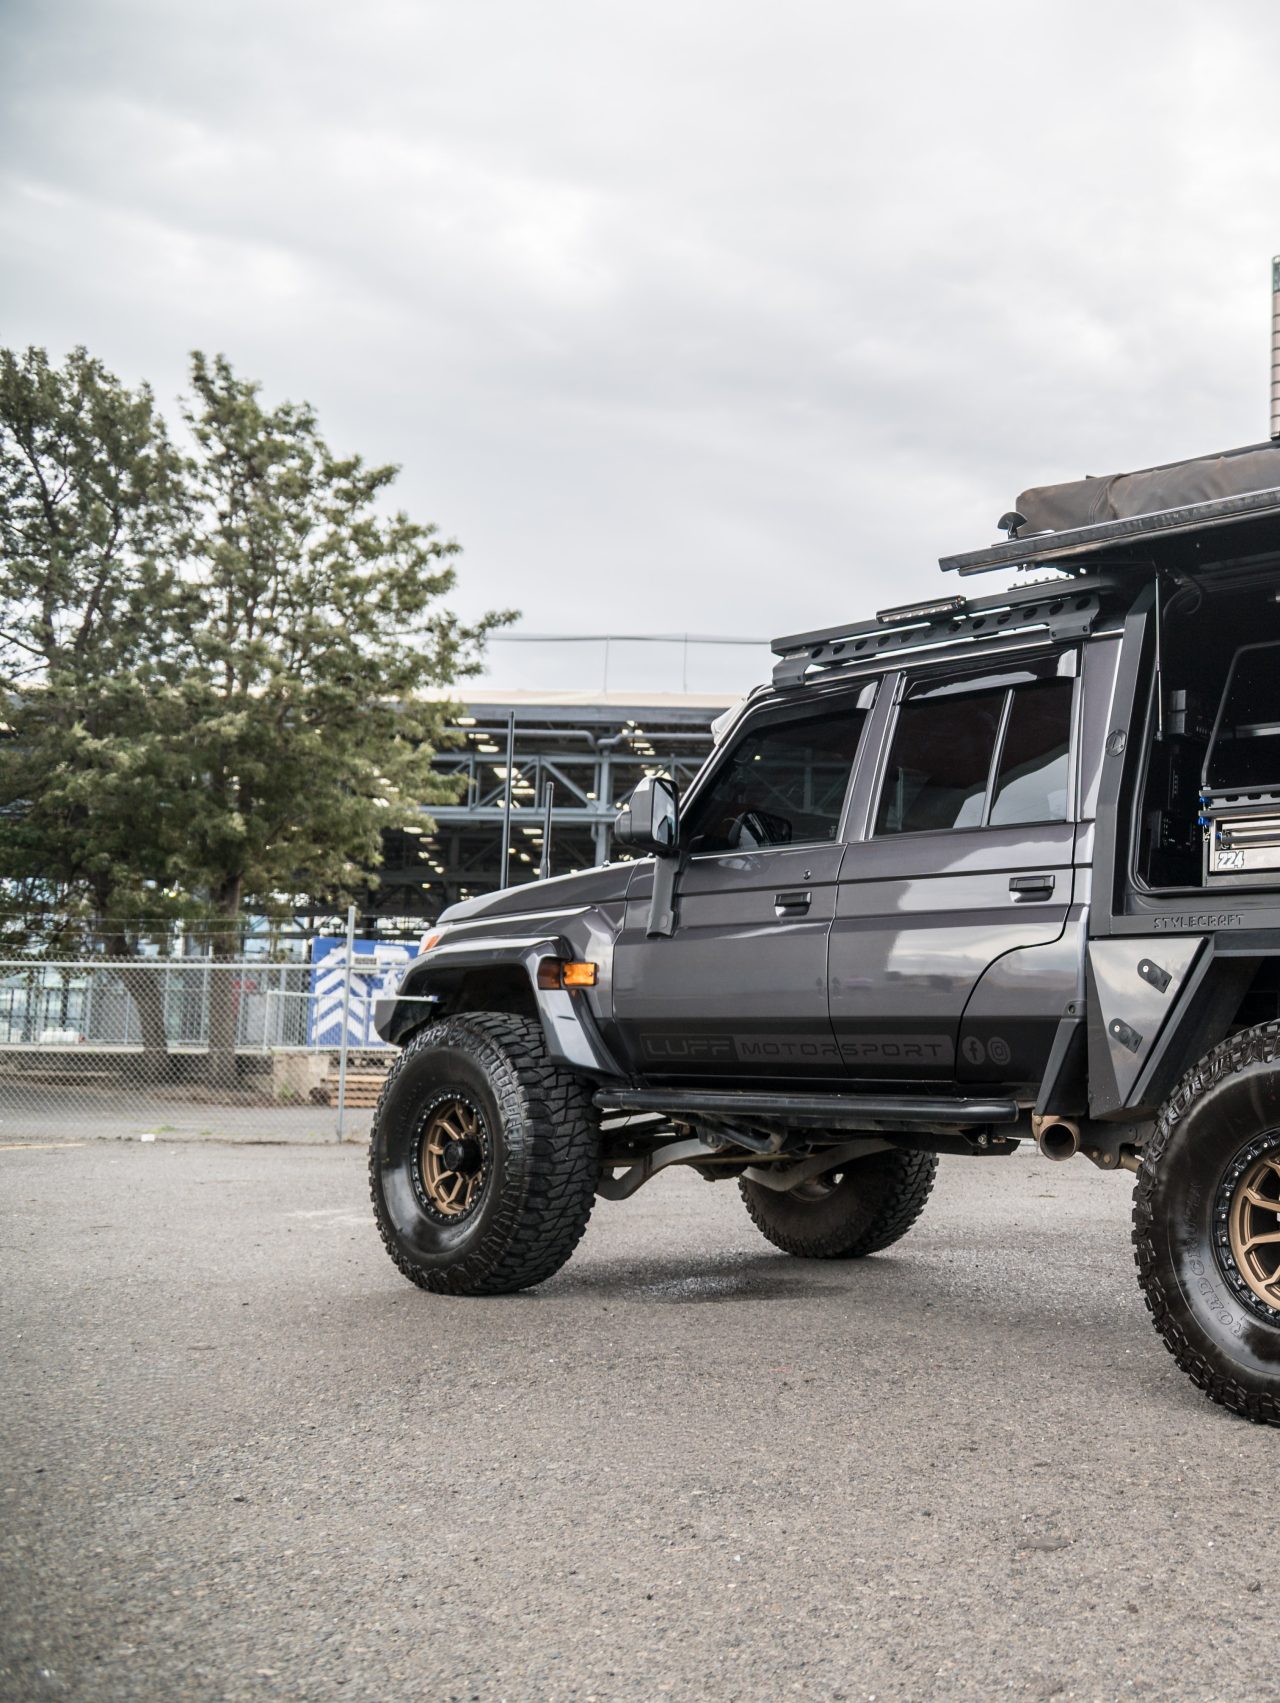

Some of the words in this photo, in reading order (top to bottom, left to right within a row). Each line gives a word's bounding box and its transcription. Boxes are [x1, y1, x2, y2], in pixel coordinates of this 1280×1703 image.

[1218, 851, 1244, 869] 224
[1154, 914, 1245, 929] STYLECRAFT
[646, 1040, 730, 1056] LUFF
[741, 1042, 943, 1058] MOTORSPORT
